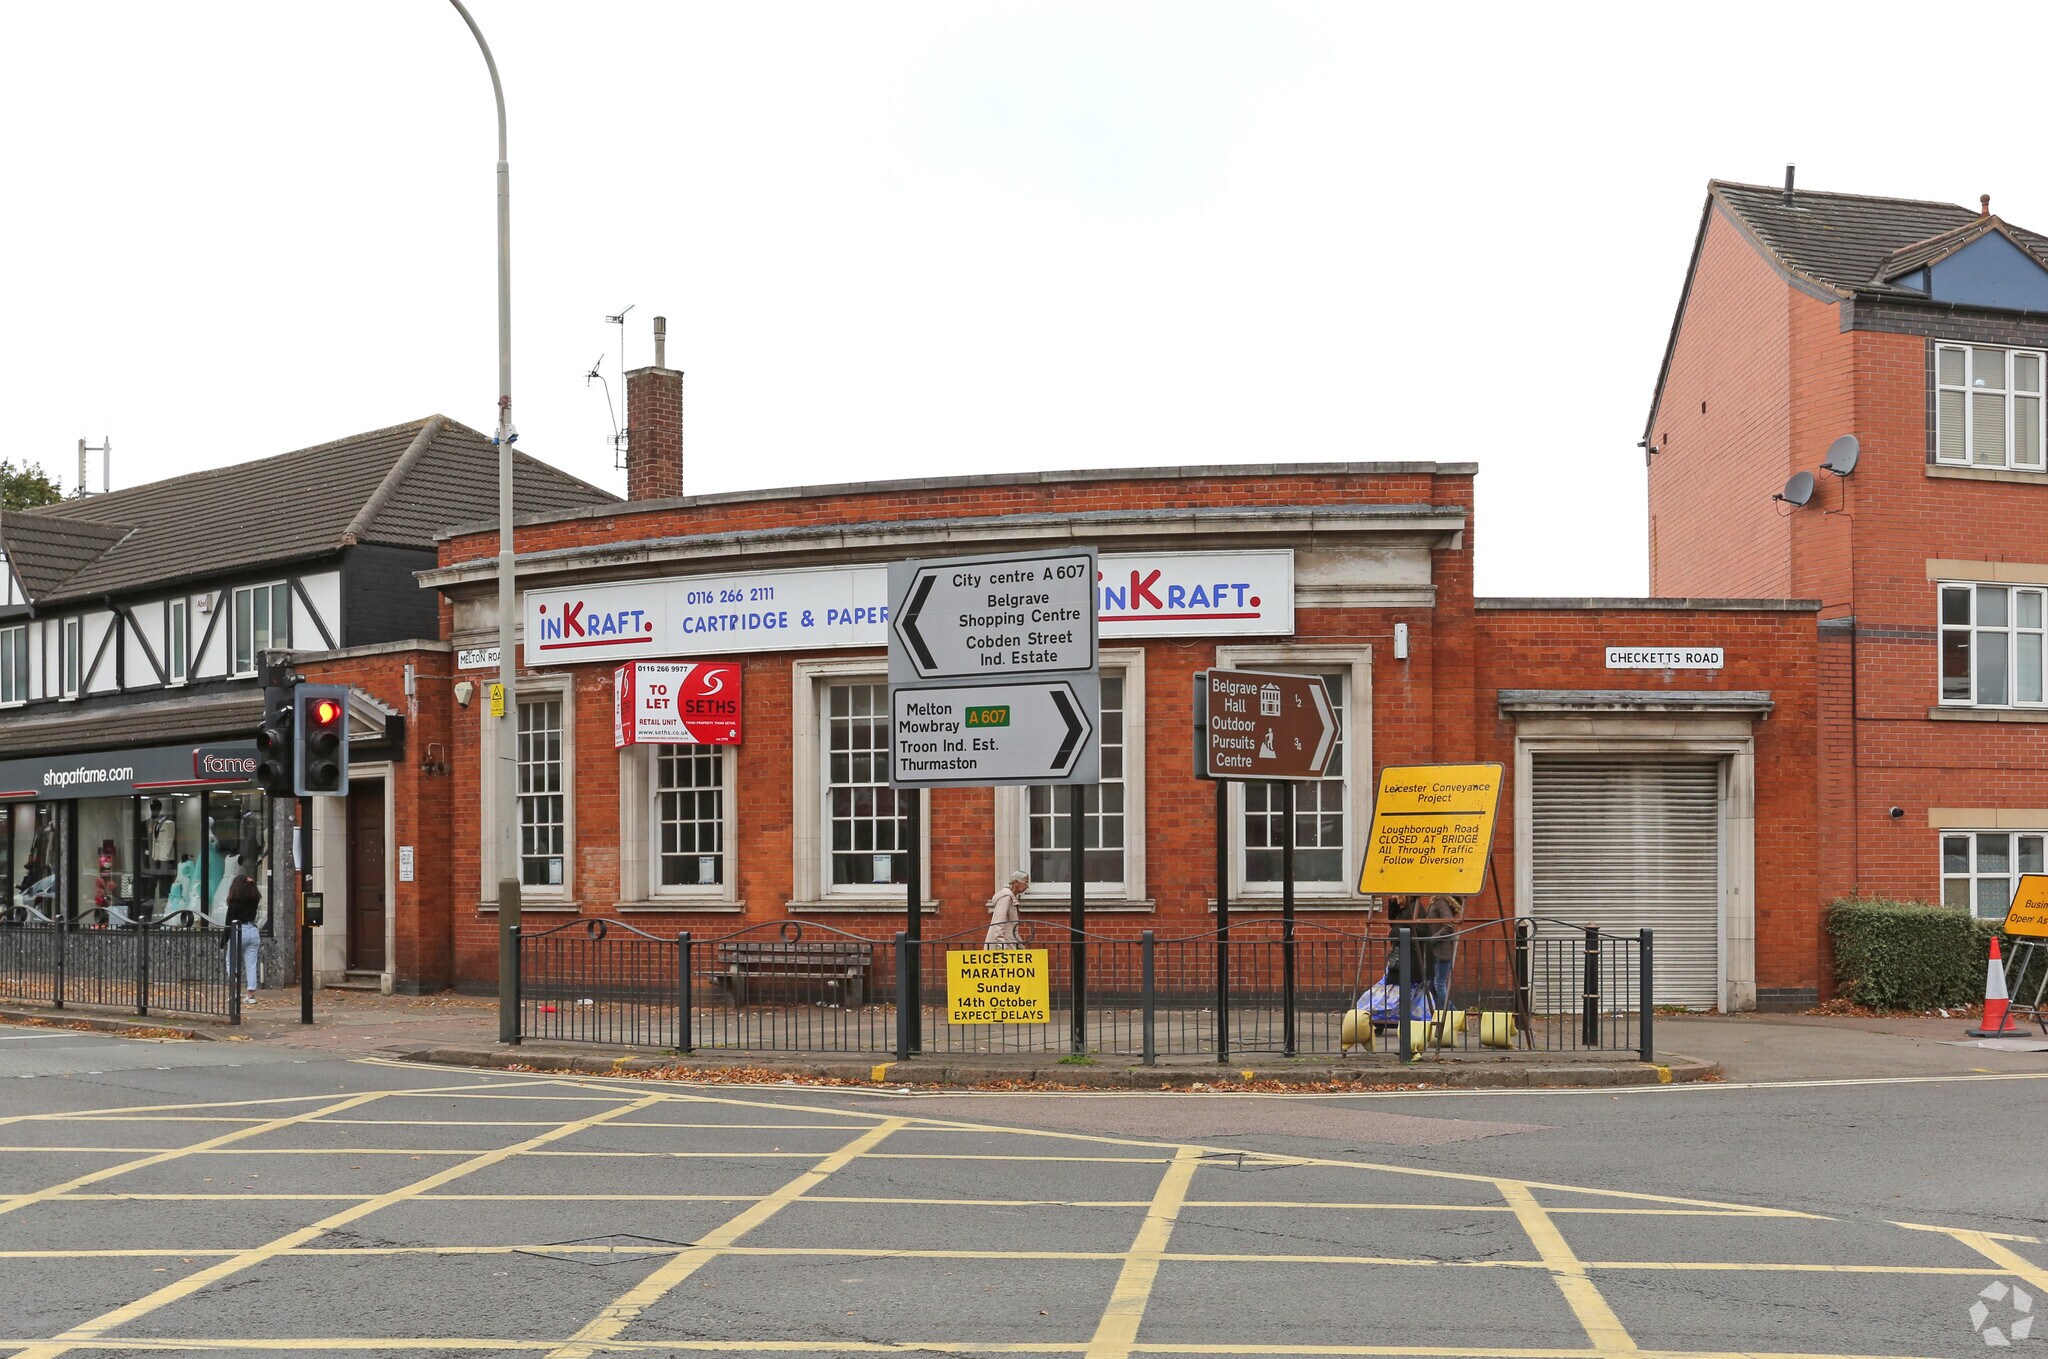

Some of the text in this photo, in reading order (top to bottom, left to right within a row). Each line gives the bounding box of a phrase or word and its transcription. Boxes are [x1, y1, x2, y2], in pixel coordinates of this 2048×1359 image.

[953, 574, 981, 588] City
[989, 570, 1034, 584] centre
[687, 587, 774, 605] 0116 266 2111
[987, 593, 1049, 608] Belgrave
[682, 611, 788, 634] CARTRIDGE
[800, 609, 815, 628] &
[959, 608, 1081, 628] Shopping Centre
[966, 630, 1073, 649] Cobden Street
[460, 654, 486, 664] MELTON
[980, 649, 1058, 666] Ind. Estate
[1610, 652, 1719, 663] CHECKETTS ROAD
[649, 684, 667, 695] TO
[1212, 678, 1257, 696] Belgrave
[646, 698, 670, 709] LET
[685, 700, 736, 714] SETHS
[906, 703, 952, 716] Melton
[1224, 698, 1246, 713] Hall
[639, 718, 659, 726] RETAIL
[661, 718, 677, 726] UNIT
[899, 719, 960, 734] Mowbray
[1212, 715, 1256, 732] Outdoor
[900, 737, 999, 753] Troon Ind. Est.
[1212, 734, 1255, 750] Pursuits
[203, 754, 257, 773] fame
[900, 757, 977, 771] Thurmaston
[1216, 752, 1252, 768] Centre
[43, 766, 133, 788] shopatfame.com
[1384, 782, 1490, 793] Leicester Conveyance
[1417, 793, 1452, 804] Project
[1382, 824, 1479, 835] Loughborough Road
[1379, 834, 1478, 844] CLOSED AT BRIDGE
[1378, 844, 1474, 856] All Through Traffic
[1383, 855, 1464, 865] Follow Diversion
[962, 953, 1033, 964] LEICESTER
[961, 967, 1035, 979] MARATHON
[977, 983, 1021, 994] Sunday
[958, 997, 1037, 1007] 14th October
[954, 1010, 1044, 1020] EXPECT DELAYS
